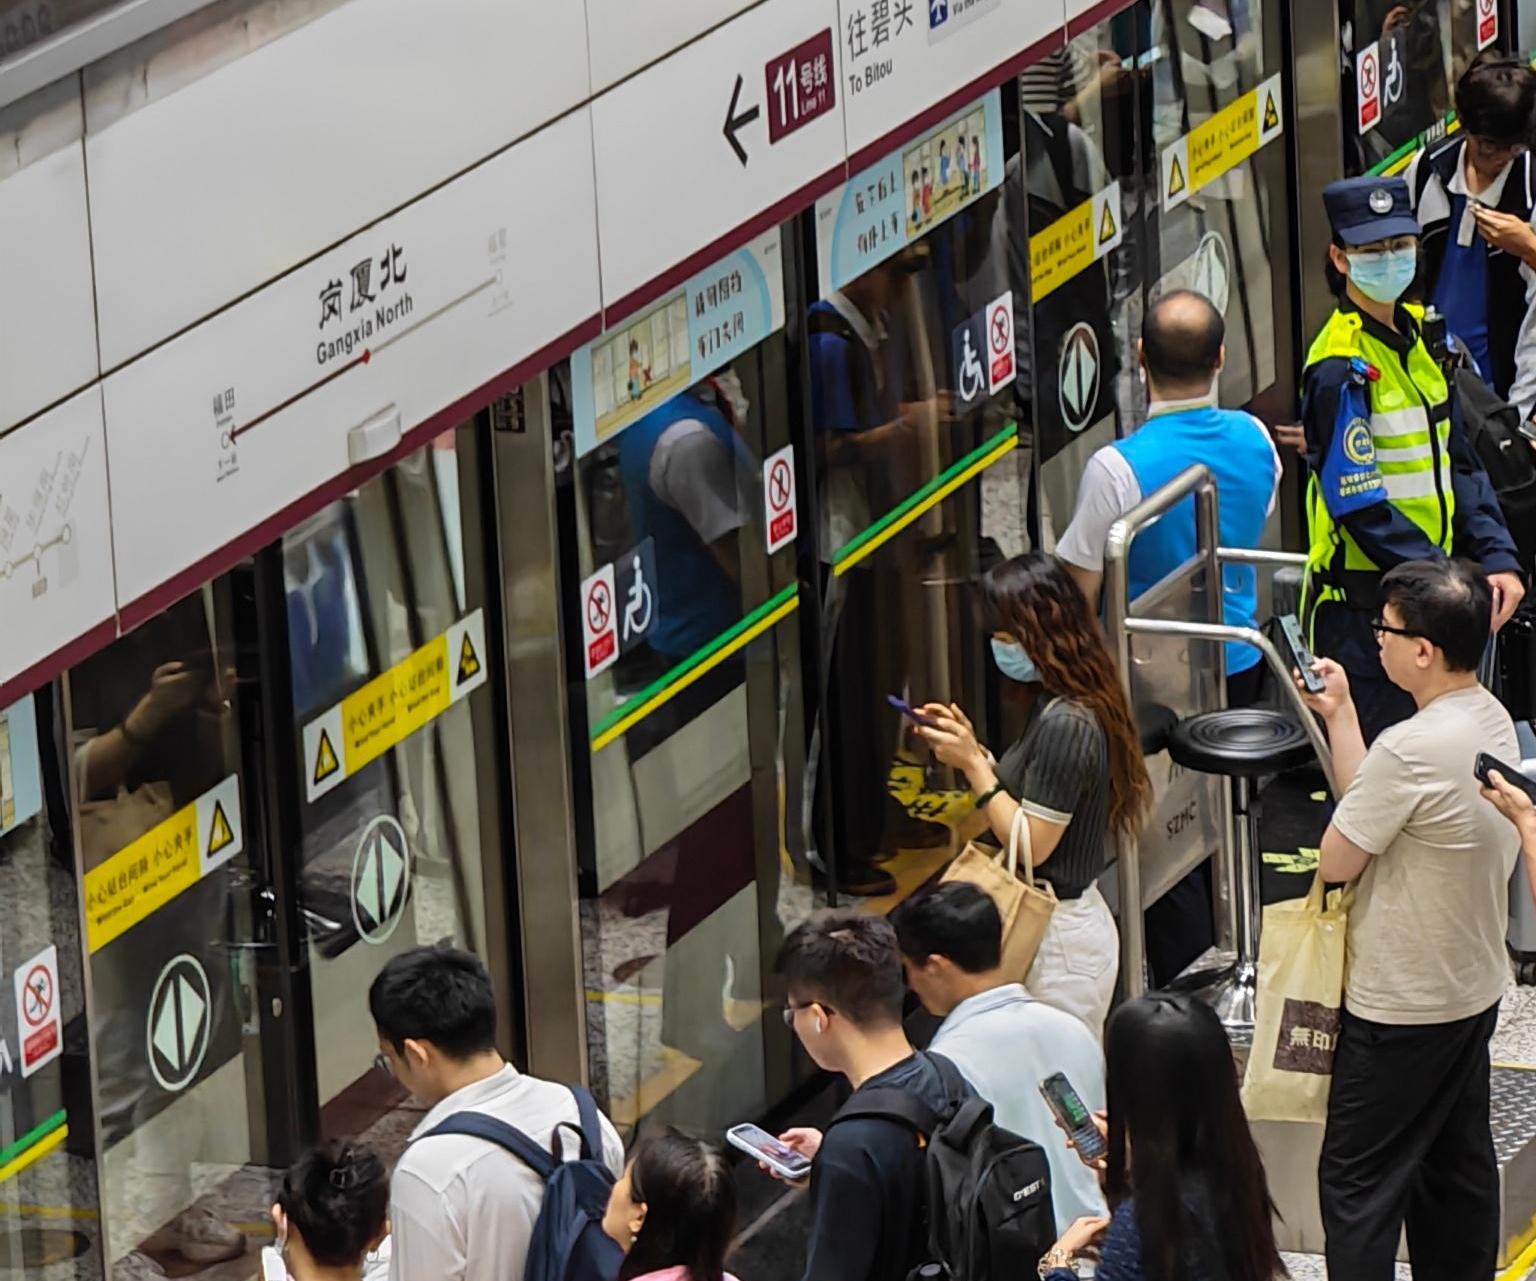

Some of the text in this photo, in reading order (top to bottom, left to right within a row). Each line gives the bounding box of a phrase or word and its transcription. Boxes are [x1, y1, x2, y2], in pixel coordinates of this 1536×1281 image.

[773, 58, 799, 127] 11
[800, 53, 828, 95] 号线
[849, 59, 893, 96] To Bitou
[318, 242, 408, 331] 岗厦北
[316, 293, 414, 365] Gangxia North
[1289, 1025, 1340, 1052] 無印
